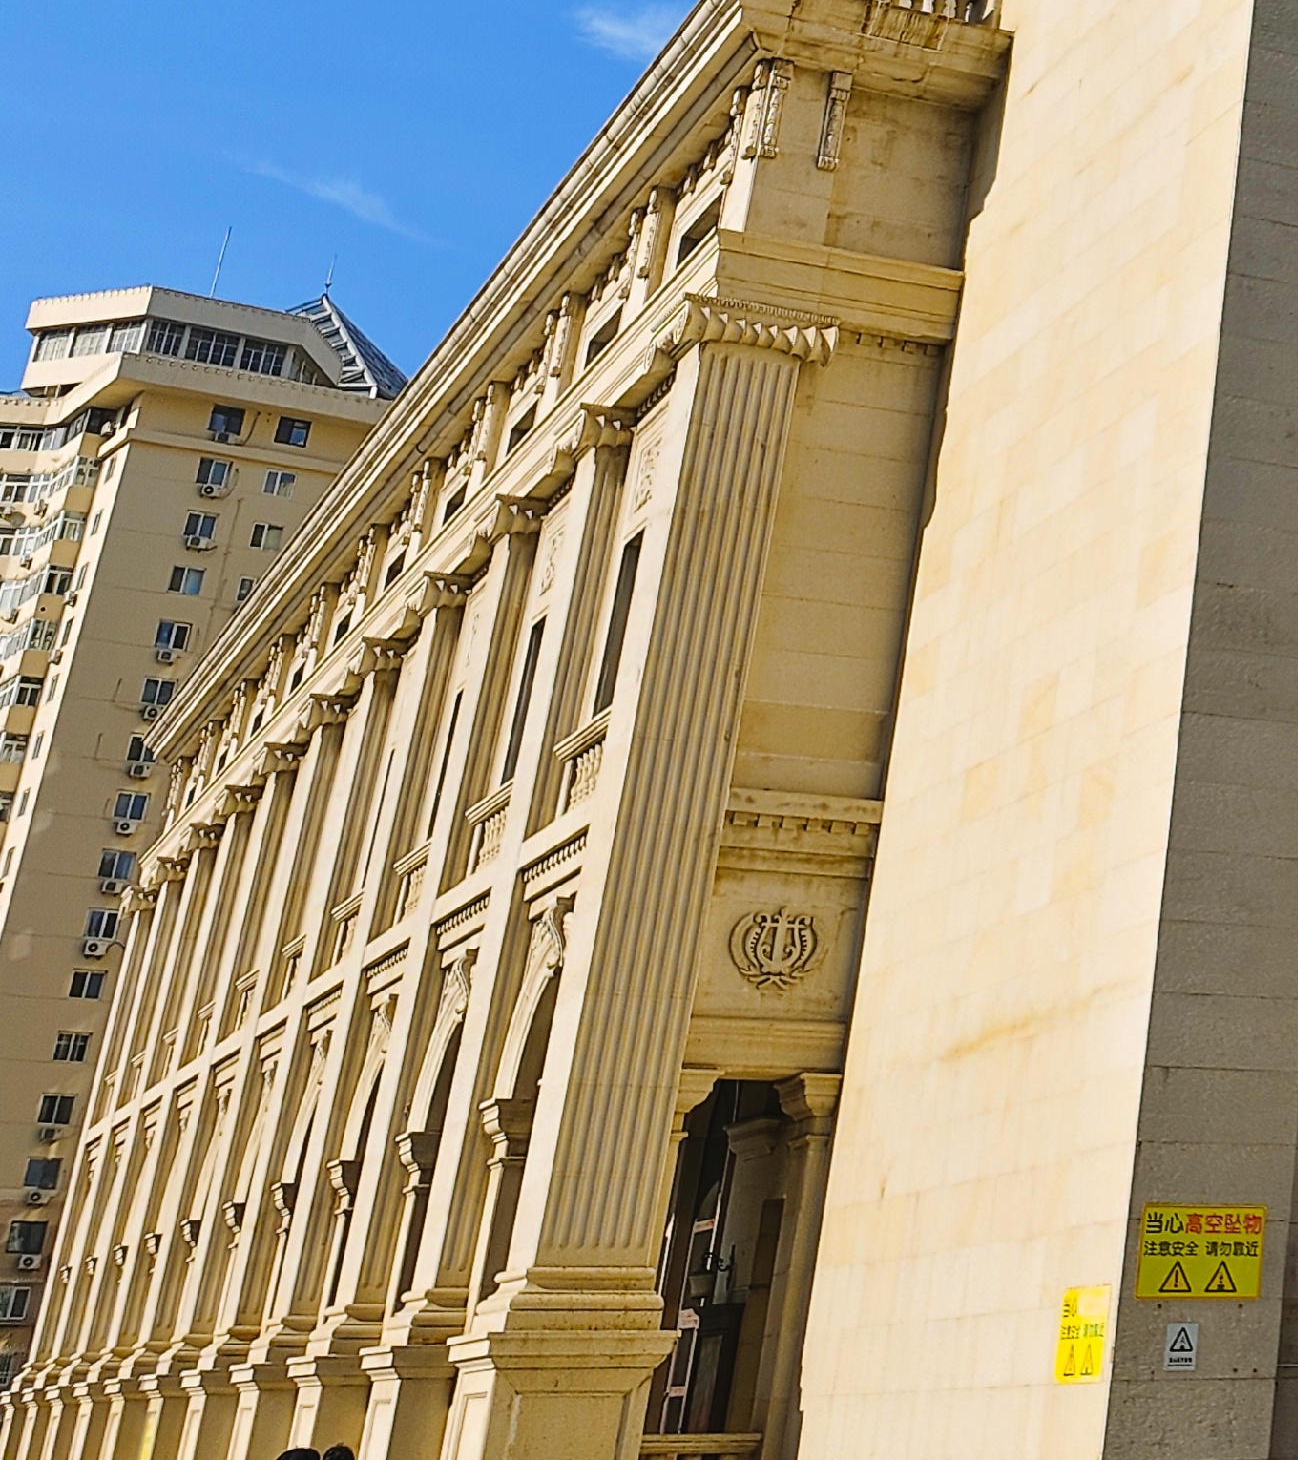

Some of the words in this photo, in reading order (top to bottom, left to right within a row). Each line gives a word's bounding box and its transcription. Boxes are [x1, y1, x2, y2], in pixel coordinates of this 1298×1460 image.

[1146, 1211, 1262, 1234] 当心高空坠物
[1143, 1241, 1199, 1257] 注意安全
[1205, 1241, 1259, 1257] 请勿靠近
